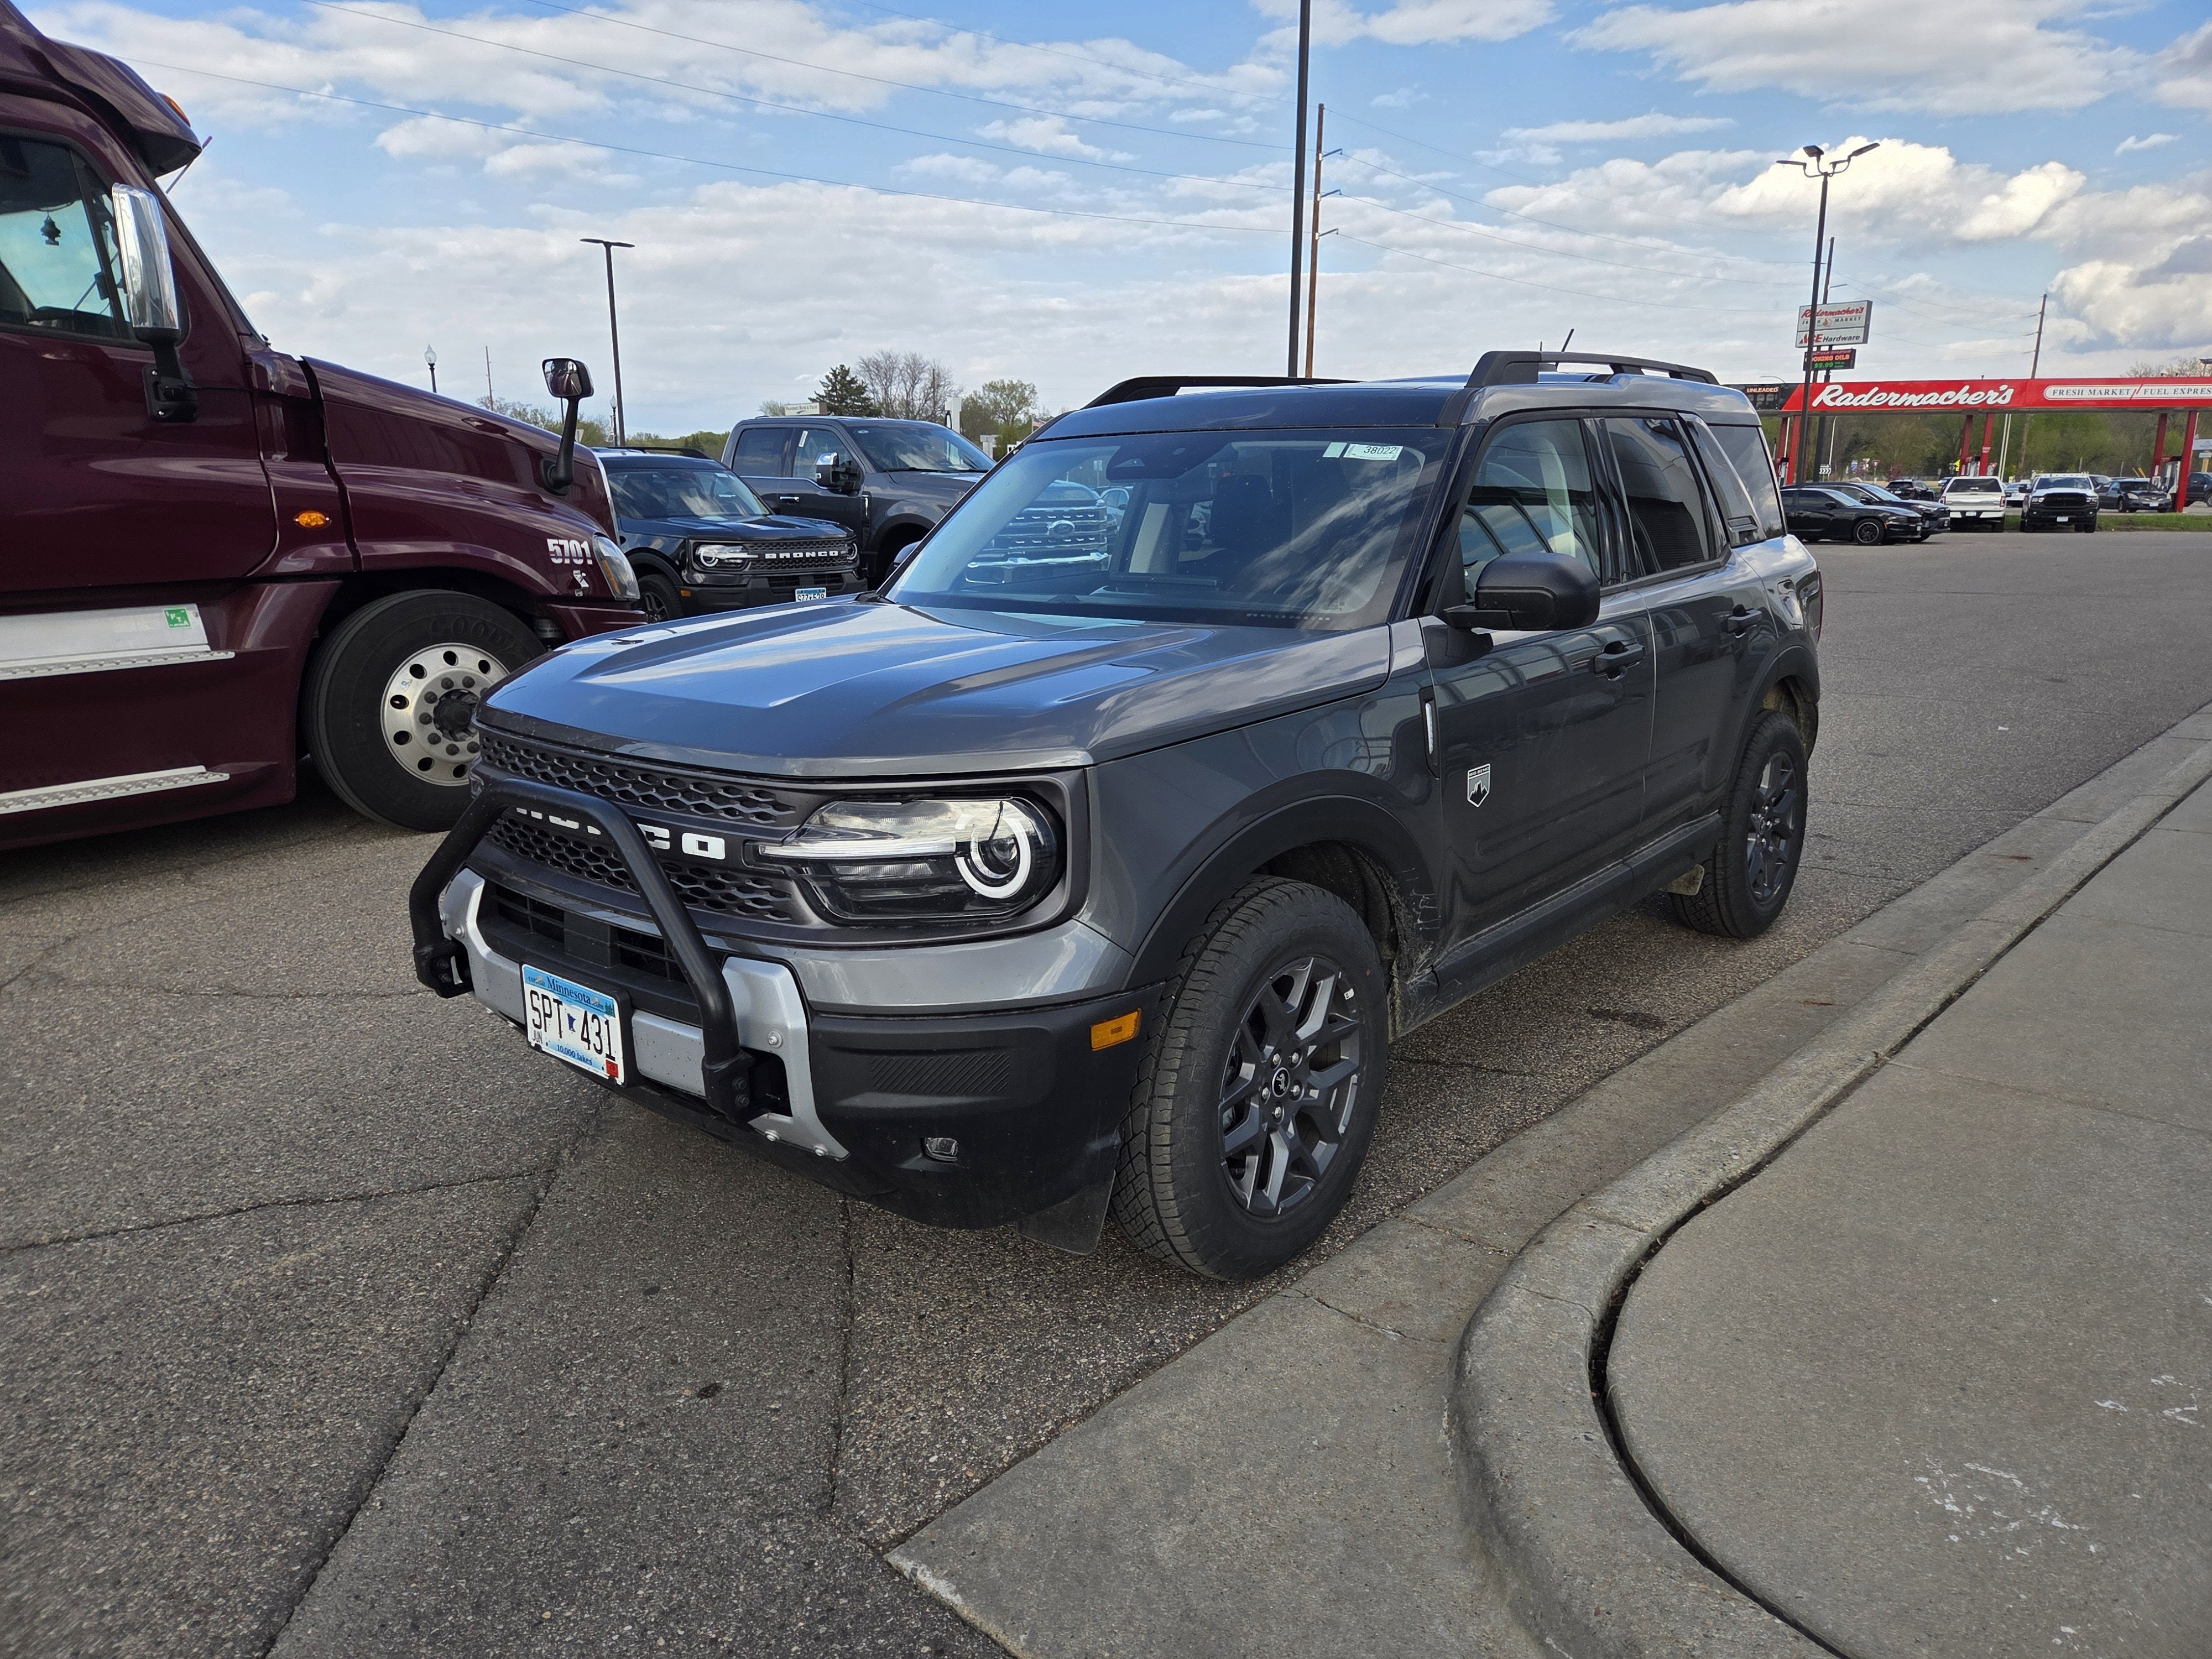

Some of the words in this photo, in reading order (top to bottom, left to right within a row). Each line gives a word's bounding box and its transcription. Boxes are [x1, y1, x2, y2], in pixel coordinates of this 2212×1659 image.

[1799, 333, 1823, 344] AE
[1812, 384, 2015, 407] Radermacher's
[1363, 446, 1397, 454] 38022
[546, 539, 593, 565] 5701
[765, 551, 838, 559] BRONCO
[546, 976, 591, 1005] Minnesota
[530, 989, 563, 1039] SPT
[581, 1010, 615, 1062] 431
[557, 1044, 576, 1058] 10,000
[577, 1053, 593, 1066] lakes
